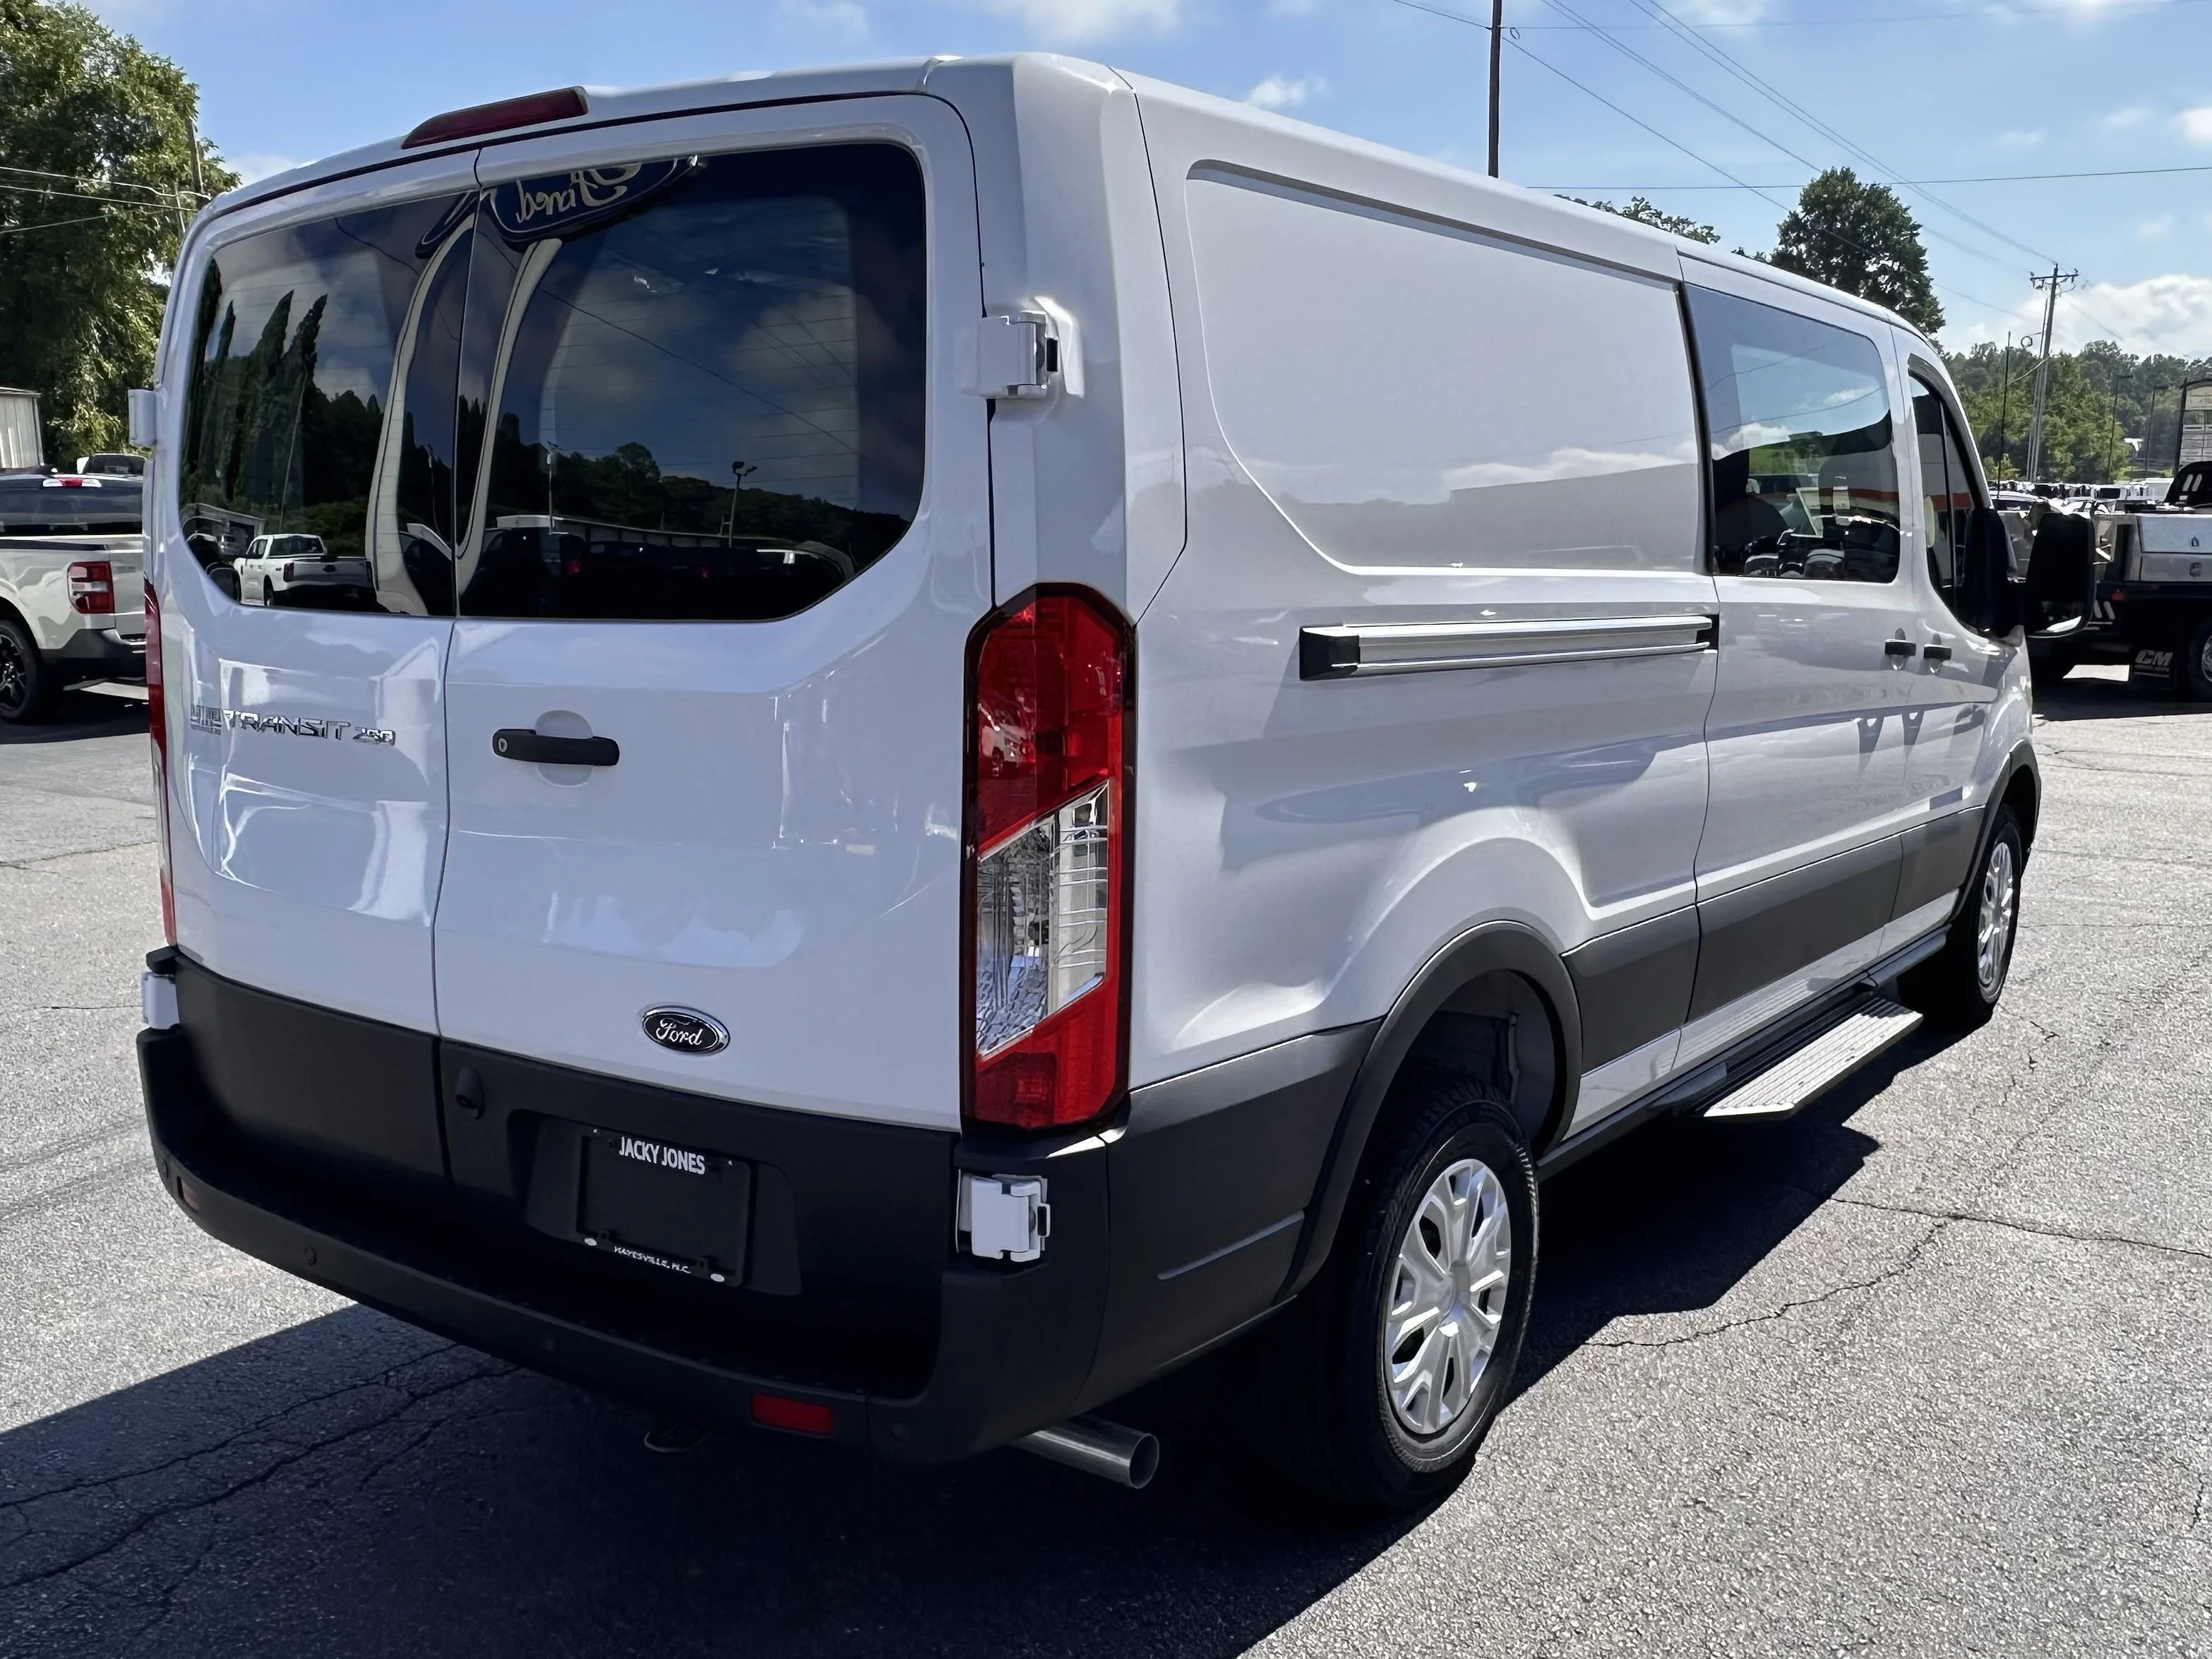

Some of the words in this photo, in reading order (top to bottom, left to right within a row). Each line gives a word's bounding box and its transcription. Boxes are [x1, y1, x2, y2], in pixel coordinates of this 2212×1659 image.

[2134, 649, 2174, 666] CM
[222, 708, 351, 740] TRANSIT
[655, 1017, 703, 1046] Ford
[618, 1136, 660, 1164] JACKY
[661, 1146, 705, 1175] JONES
